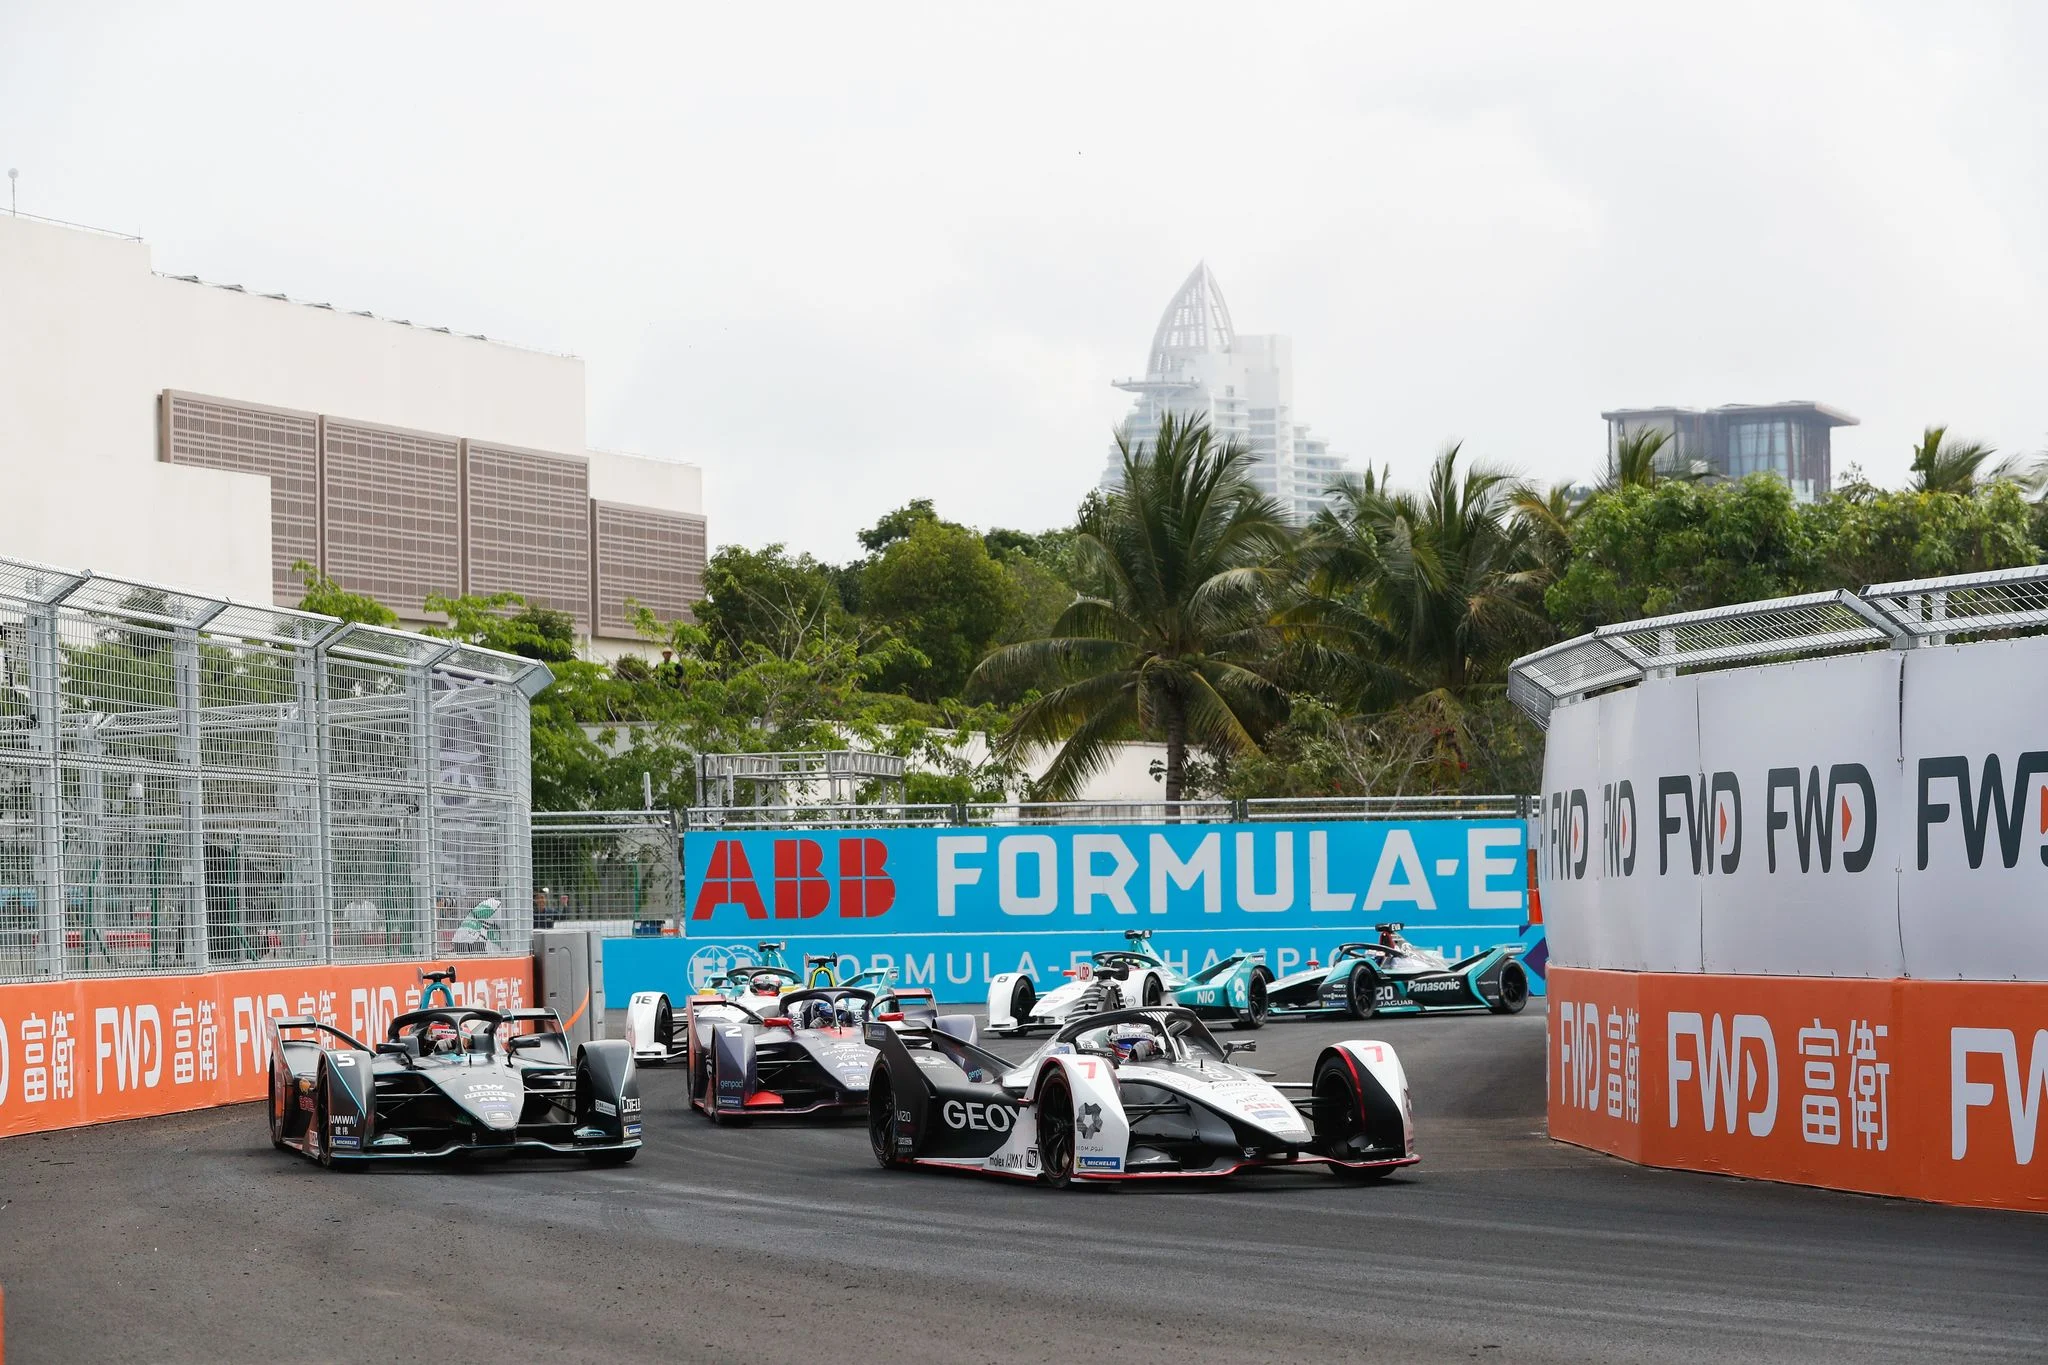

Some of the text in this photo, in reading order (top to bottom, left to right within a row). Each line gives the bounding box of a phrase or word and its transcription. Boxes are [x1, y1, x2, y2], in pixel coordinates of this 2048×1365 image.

[1551, 789, 1588, 880] FWD
[1604, 780, 1636, 878] FWD
[1659, 771, 1742, 875] FWD
[1767, 763, 1877, 874] FWD
[692, 838, 896, 920] ABB
[937, 827, 1522, 917] FORMULA-E
[1376, 986, 1394, 1000] 20
[1407, 978, 1460, 993] Panasonic
[1197, 990, 1215, 1004] NIO
[725, 1026, 742, 1037] 2
[22, 1011, 75, 1103] 富衛
[96, 1004, 162, 1094] FWD
[173, 1000, 218, 1084] 富衛
[336, 1053, 355, 1067] 5
[1363, 1045, 1384, 1062] 7
[1078, 1062, 1097, 1079] 7
[1561, 1002, 1600, 1111] FWD
[1607, 1005, 1639, 1124] 富衛
[1668, 1012, 1778, 1137] FWD
[1798, 1018, 1889, 1151] 富衛
